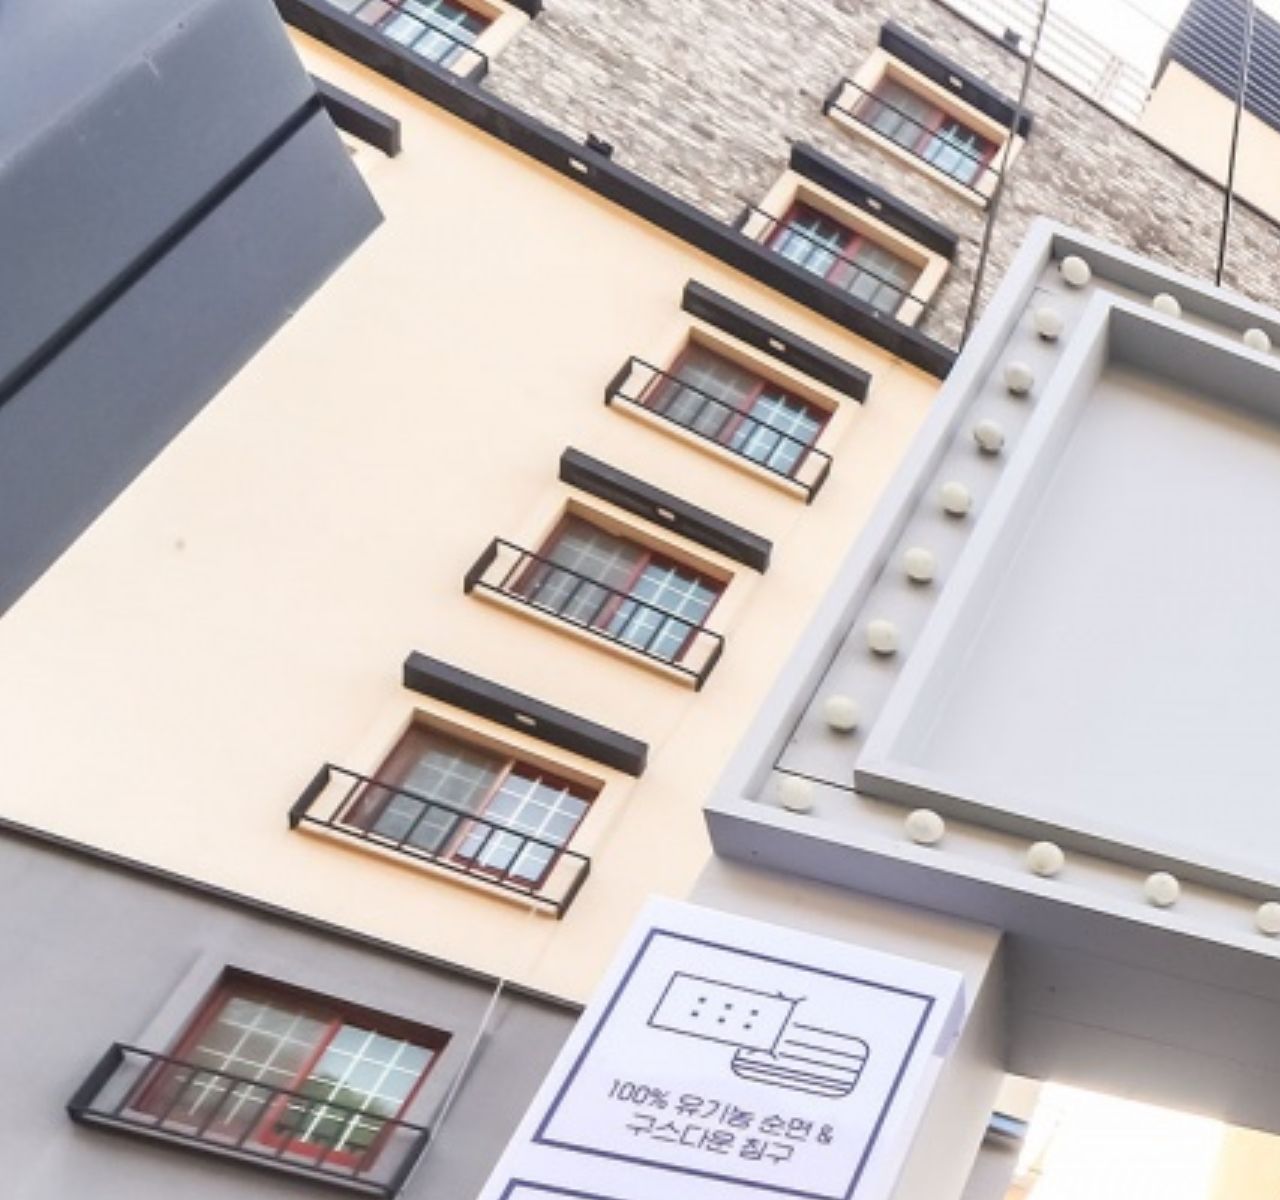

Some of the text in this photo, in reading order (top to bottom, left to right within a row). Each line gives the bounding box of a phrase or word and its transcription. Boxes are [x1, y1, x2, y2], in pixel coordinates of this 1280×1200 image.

[608, 1079, 834, 1144] 100% 유기농 순면 &
[626, 1112, 795, 1164] 구스다운 침구
